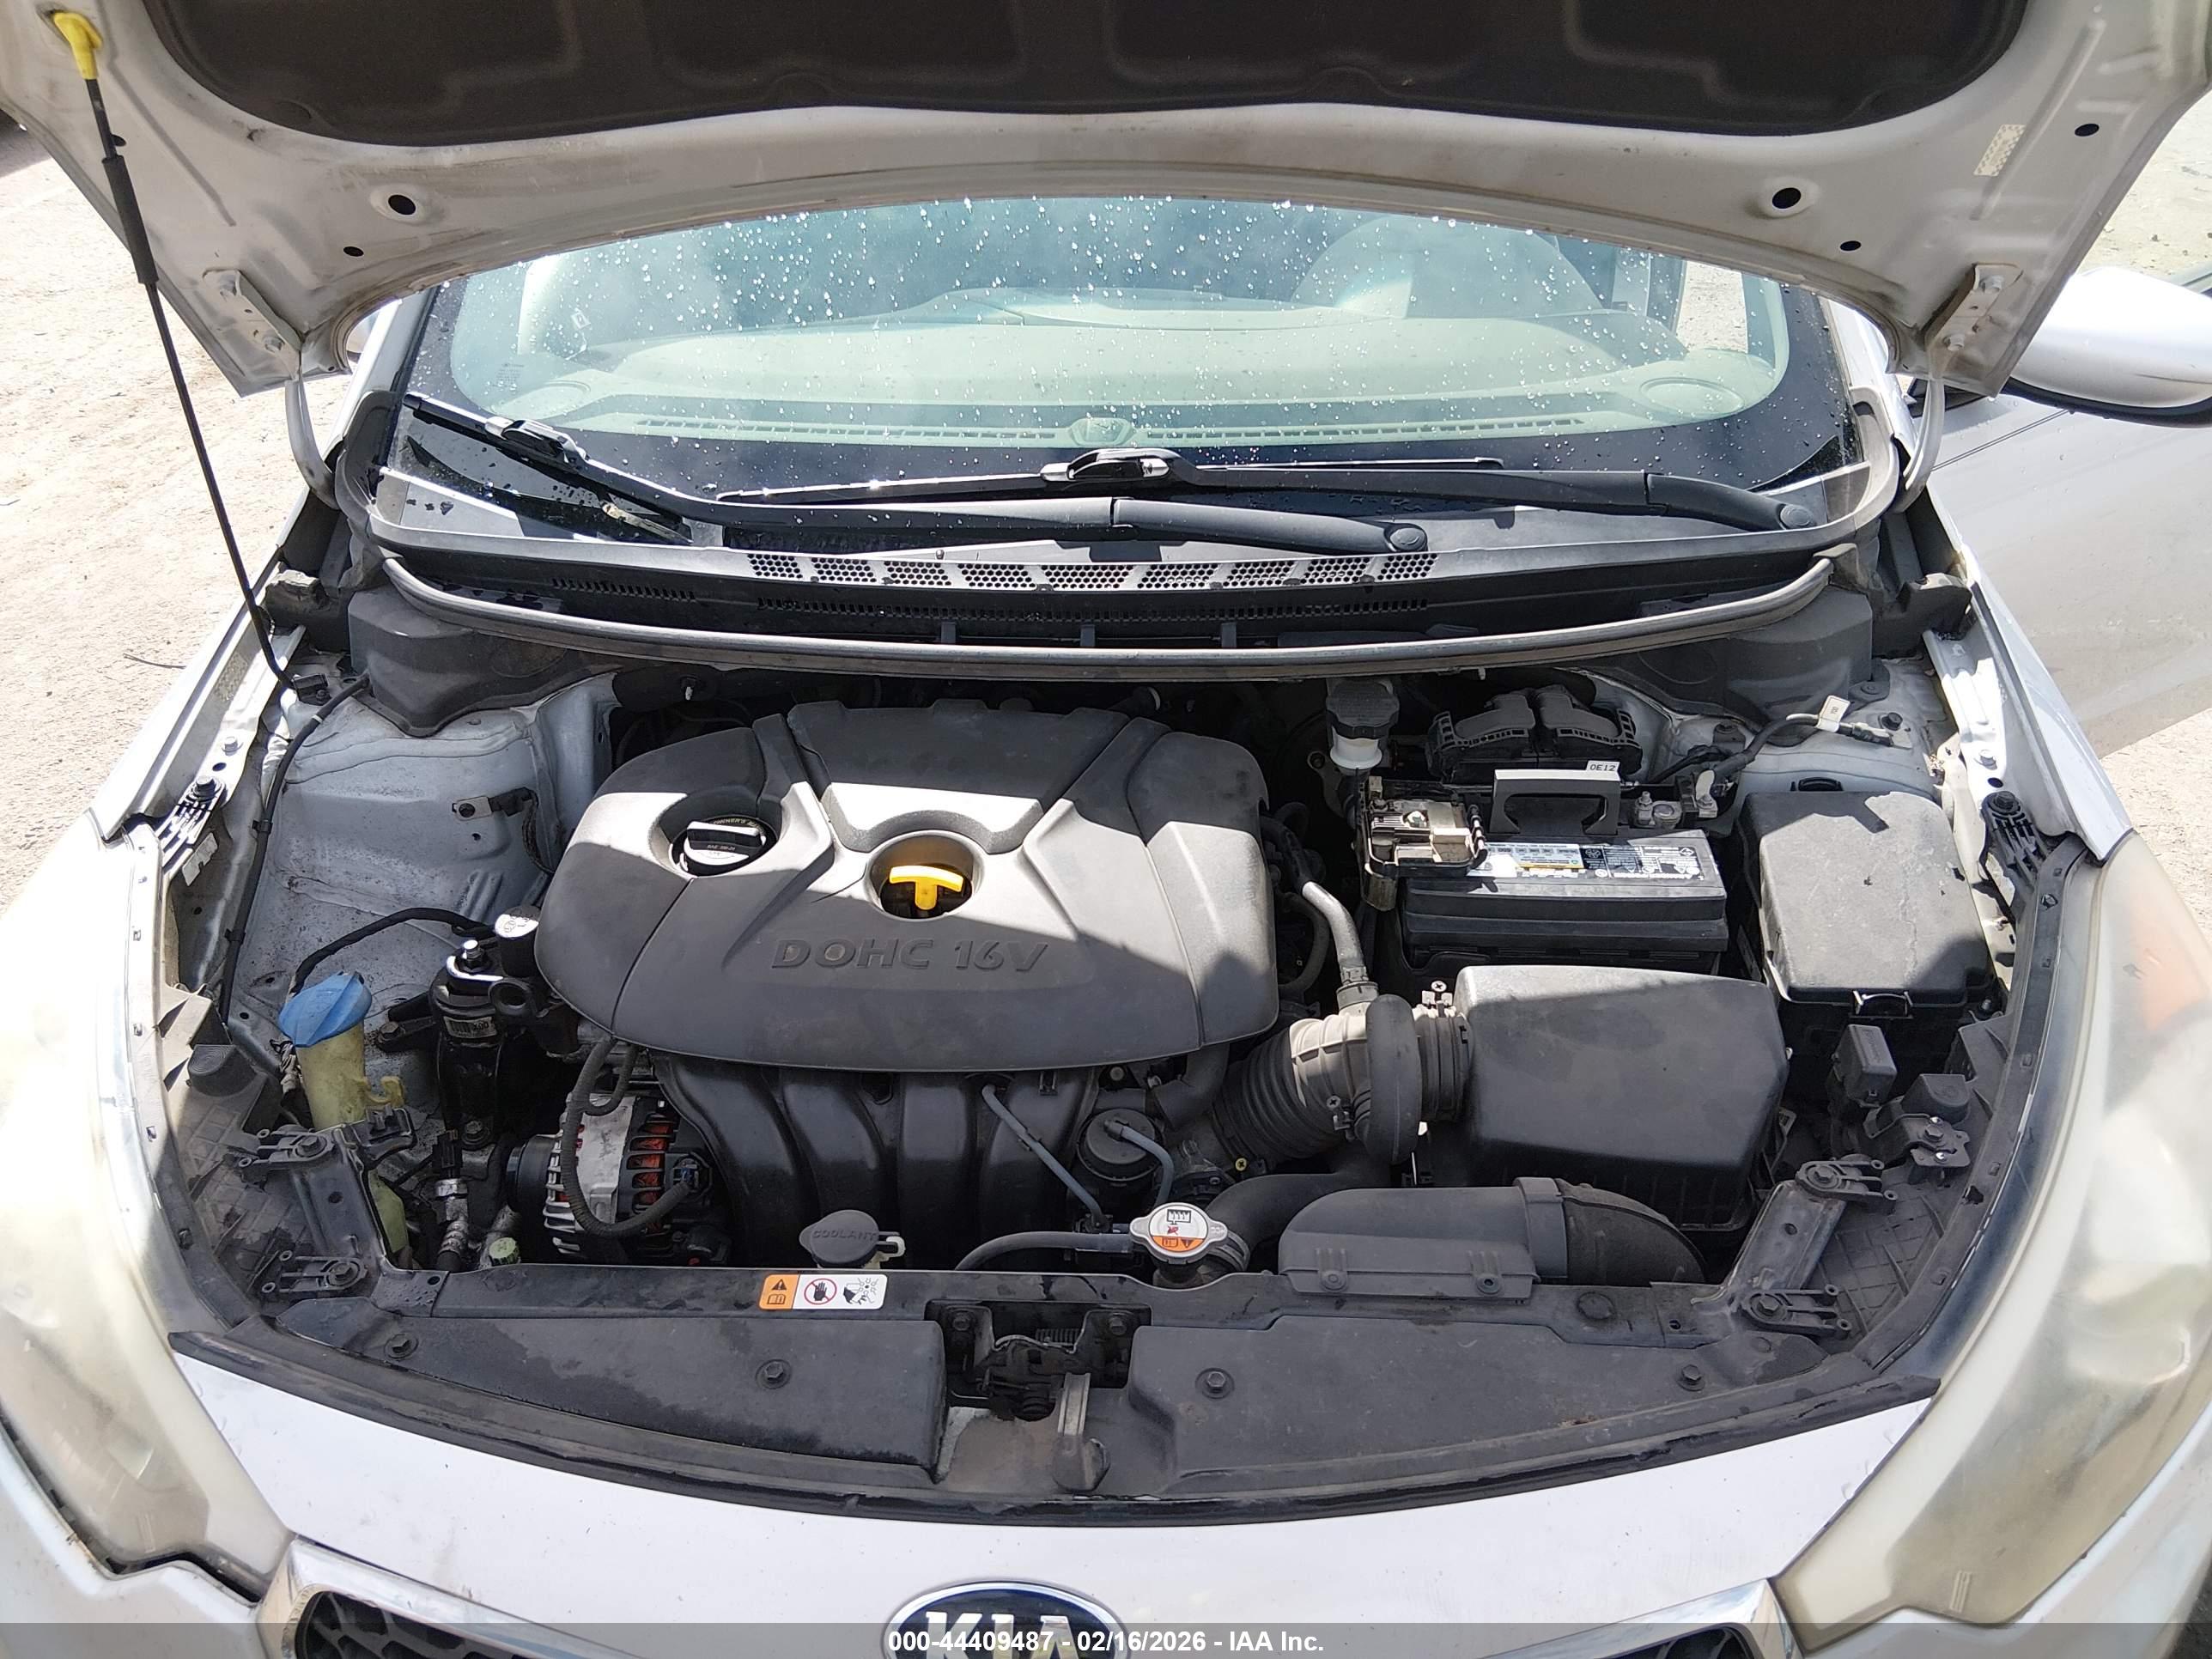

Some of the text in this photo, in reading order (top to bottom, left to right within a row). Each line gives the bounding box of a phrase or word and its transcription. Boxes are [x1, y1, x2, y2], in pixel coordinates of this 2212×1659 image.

[771, 938, 1049, 972] DOHC 16V
[811, 1229, 877, 1242] COOLANT
[925, 1611, 1081, 1659] KIA
